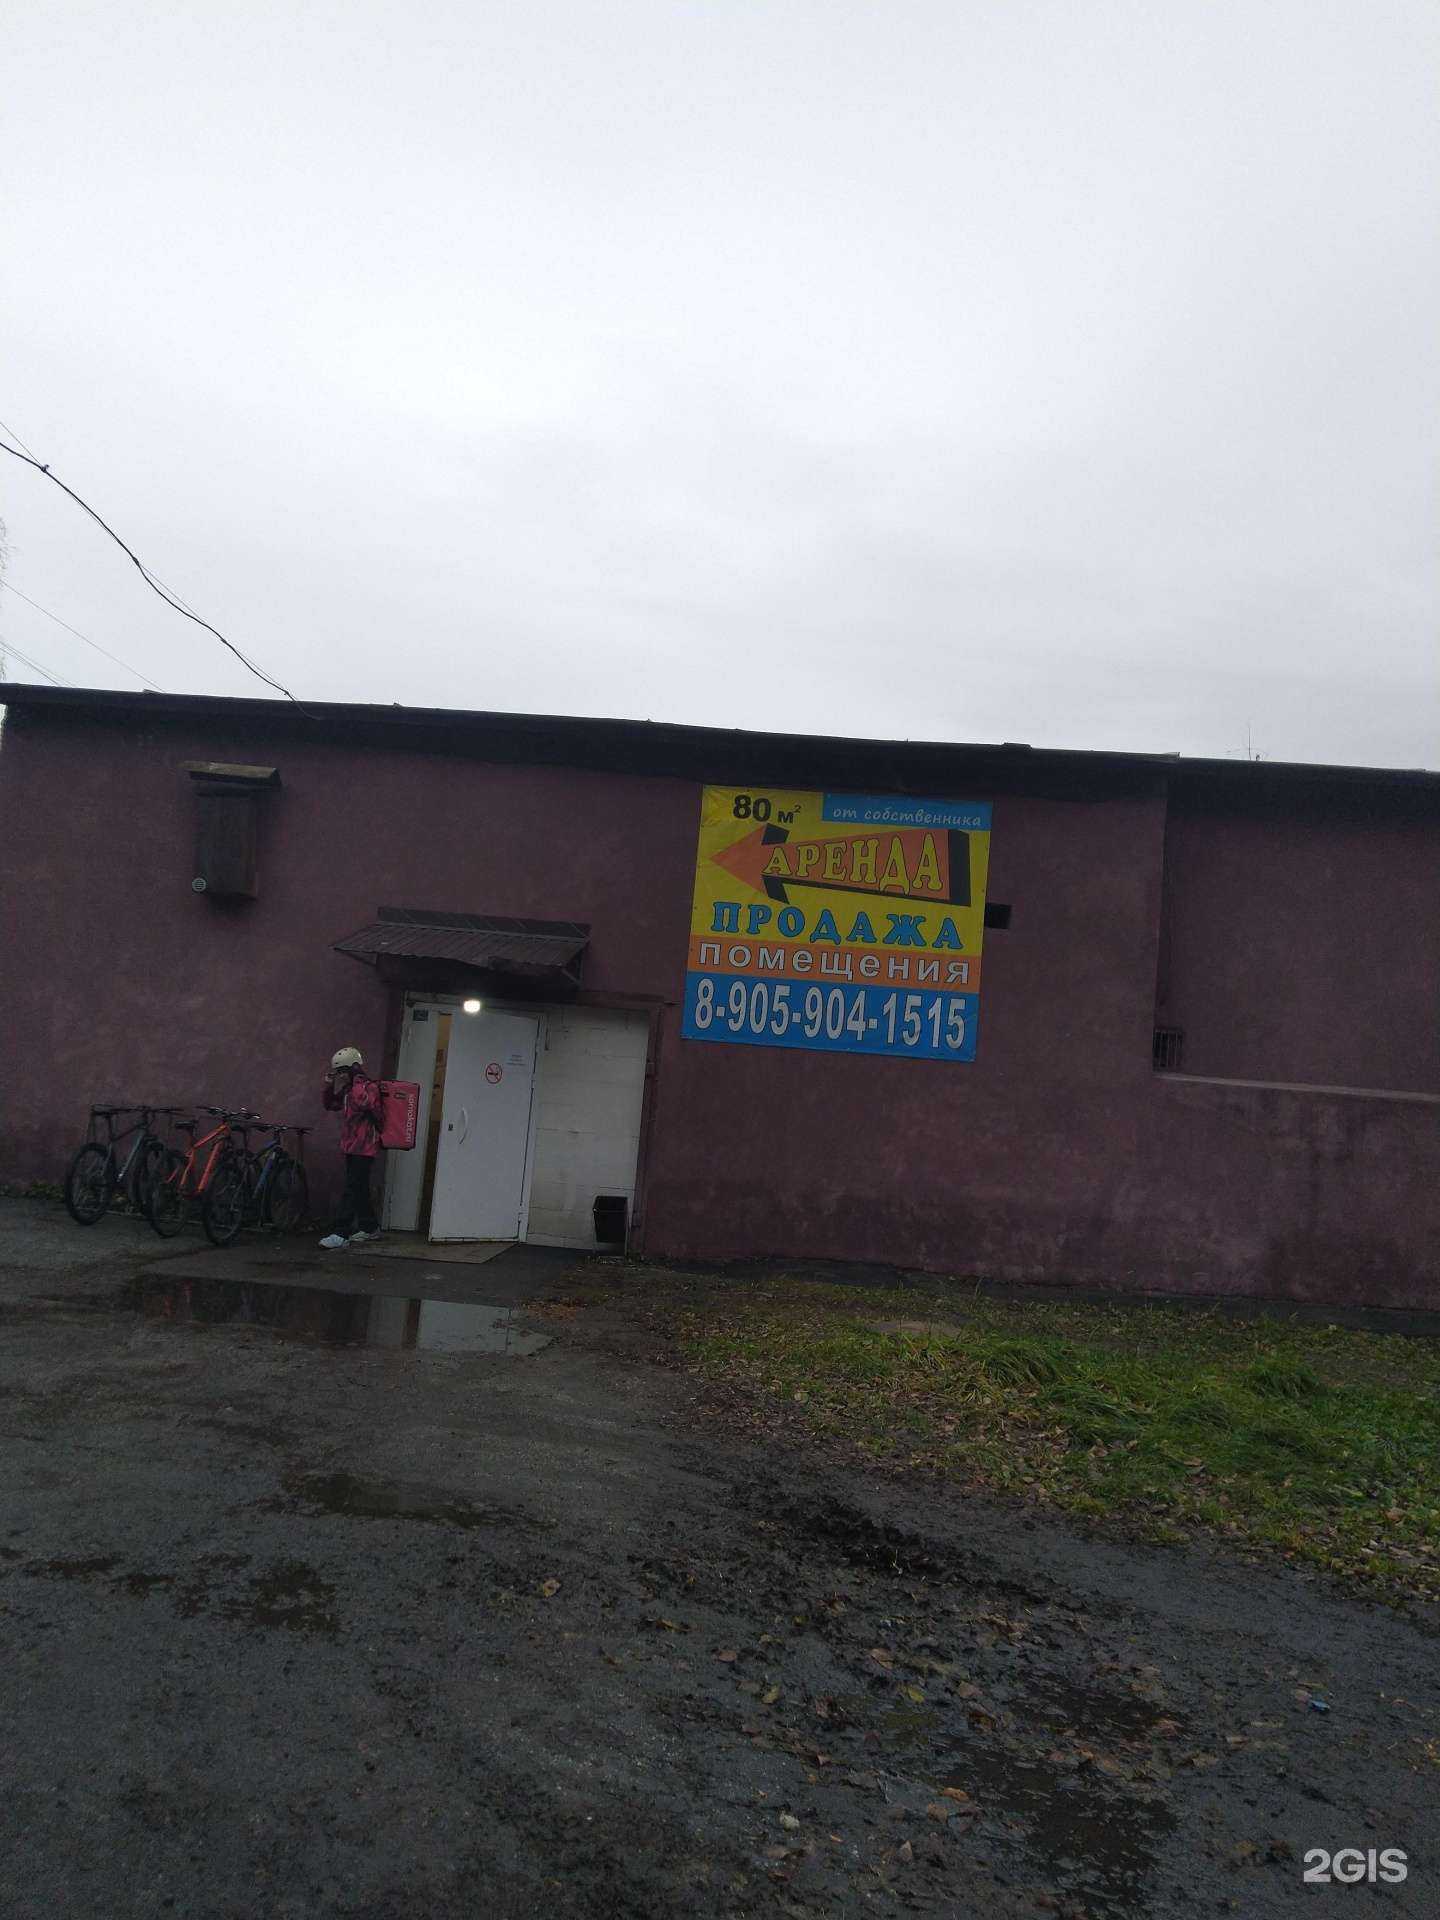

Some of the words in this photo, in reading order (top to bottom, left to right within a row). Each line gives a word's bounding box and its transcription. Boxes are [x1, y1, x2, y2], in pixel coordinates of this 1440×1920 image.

[733, 795, 771, 822] 80
[833, 807, 857, 819] от
[864, 806, 981, 826] собственника
[762, 833, 943, 896] АРЕНДА
[710, 901, 964, 949] ПРОДАЖА
[694, 978, 967, 1048] 8-905-904-1515
